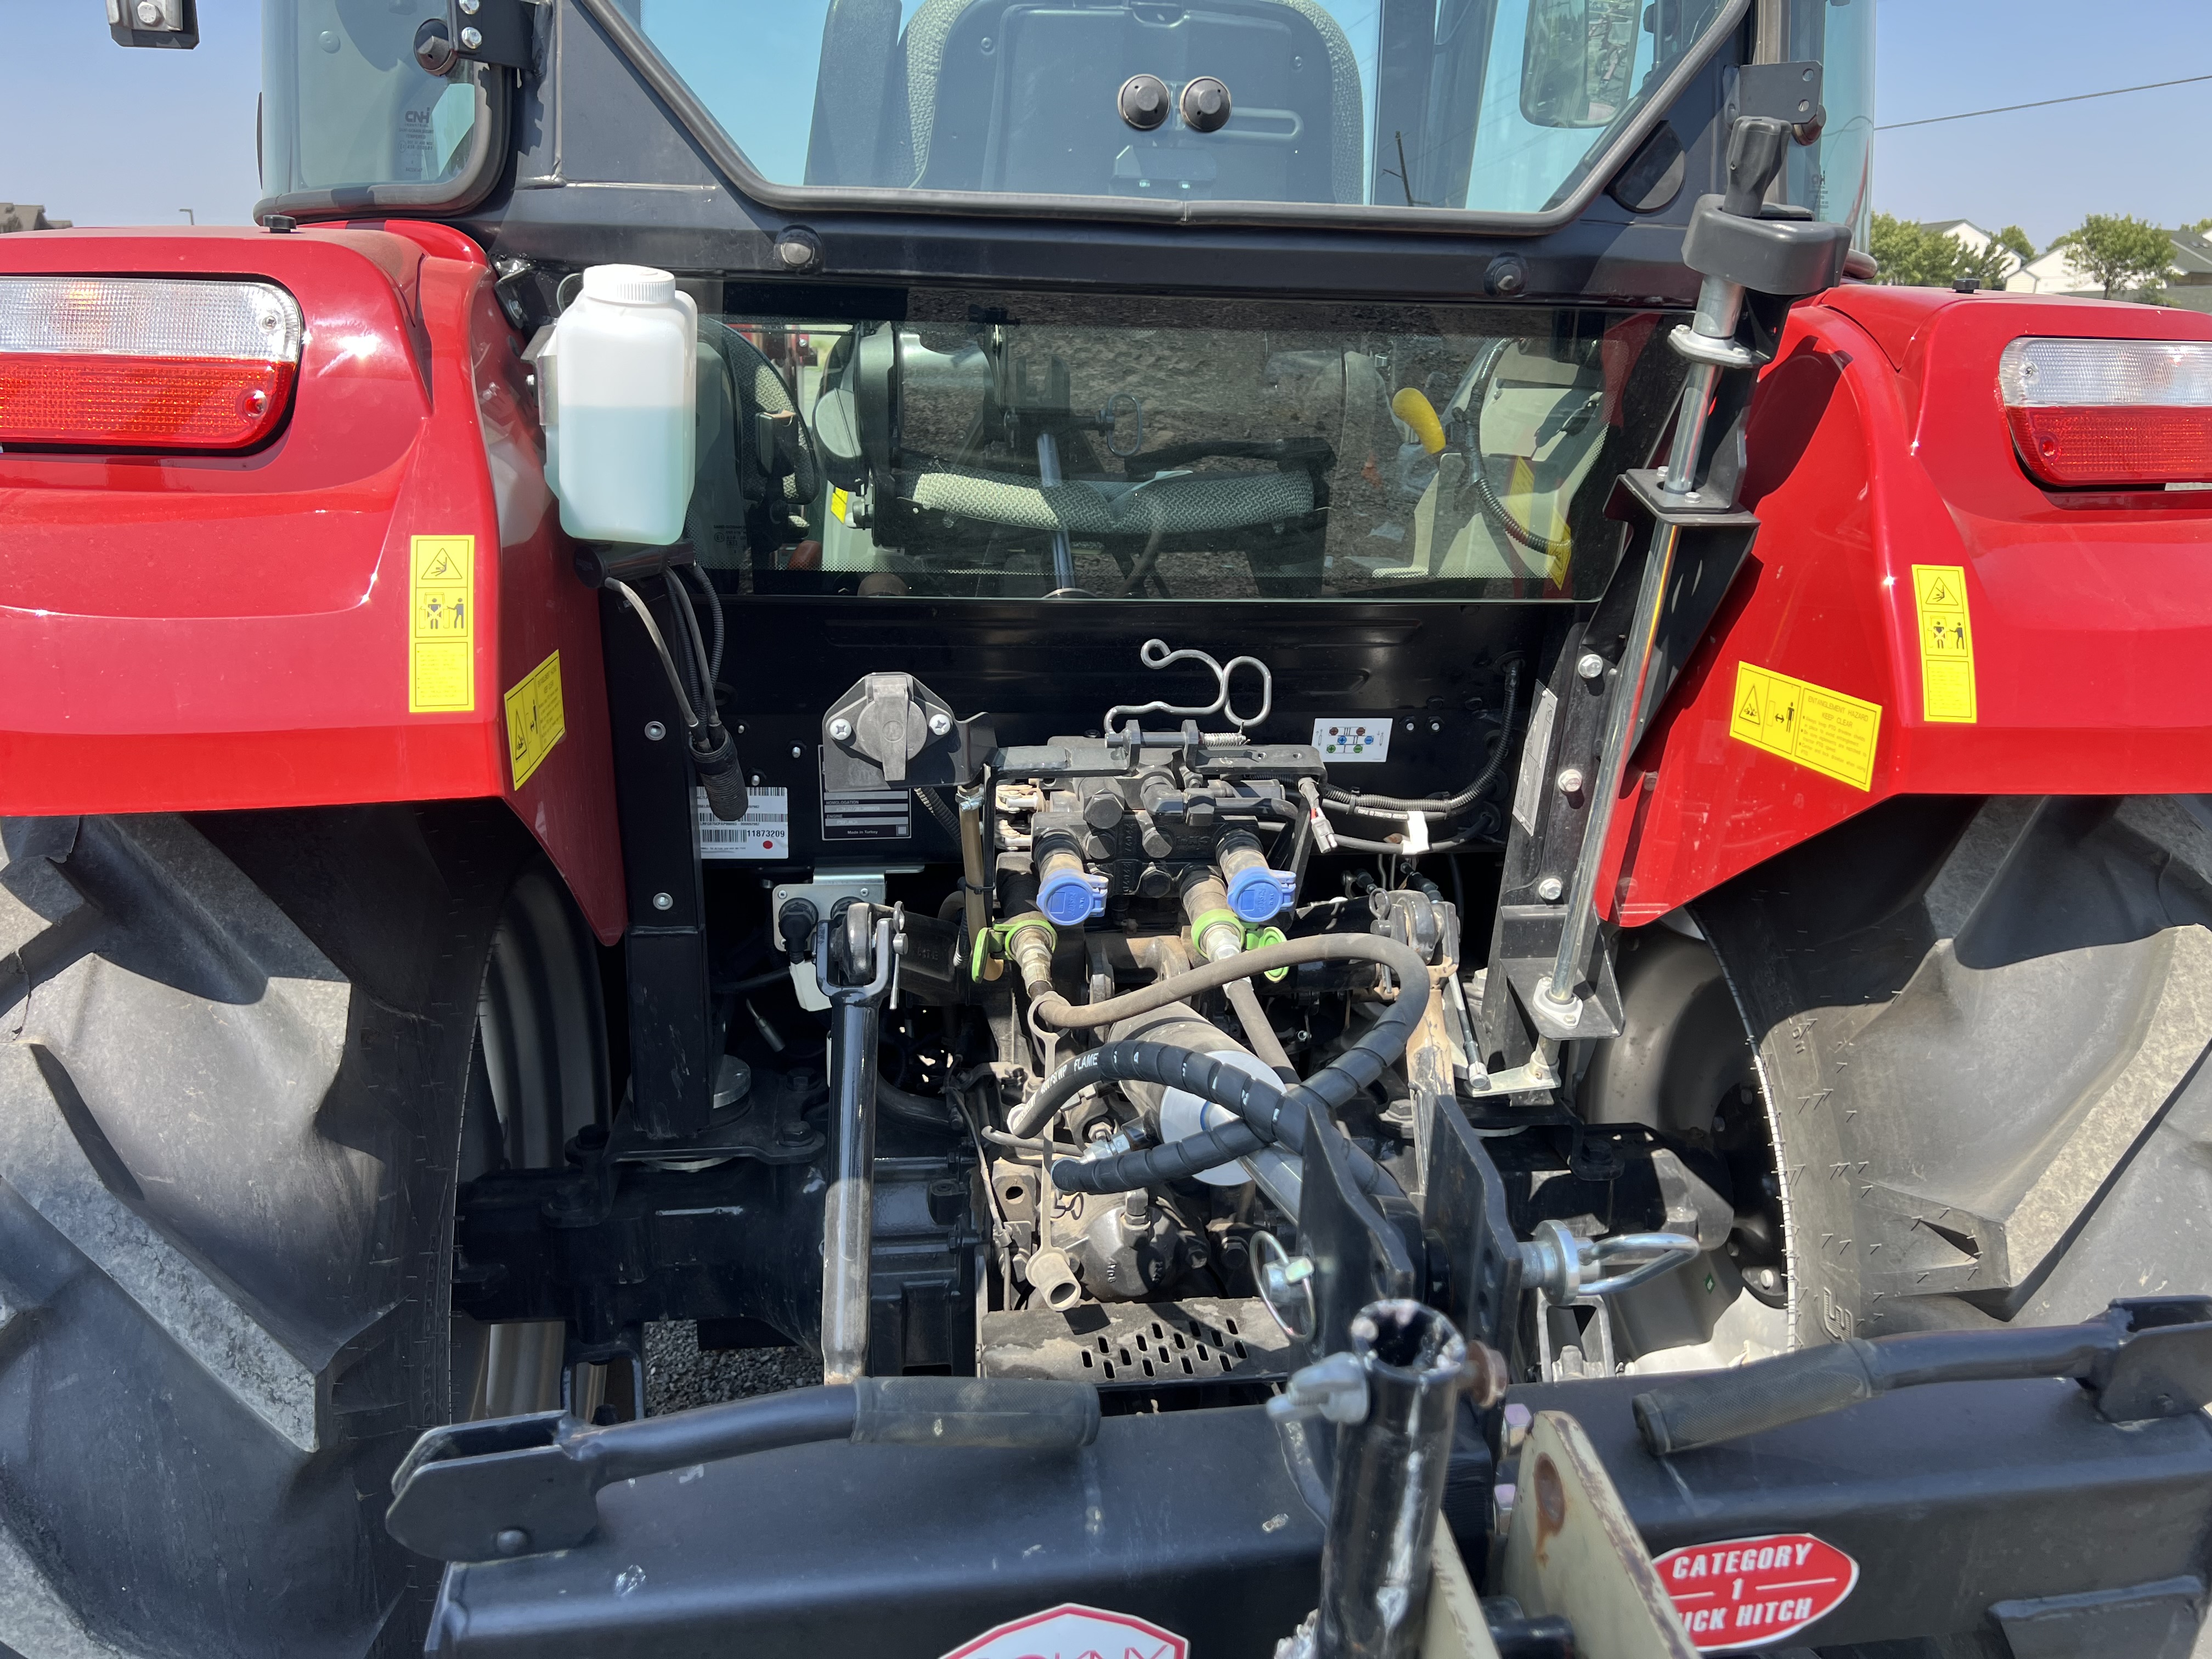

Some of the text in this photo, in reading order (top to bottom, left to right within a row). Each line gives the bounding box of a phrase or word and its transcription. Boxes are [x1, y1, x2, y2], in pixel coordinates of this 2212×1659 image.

[1808, 696, 1869, 722] ENTANGLEMENT HAZARD
[1836, 717, 1853, 728] CLEAR
[747, 830, 785, 838] 11873209
[1074, 1052, 1099, 1072] FLAME
[1672, 1542, 1814, 1579] CATEGORY
[1731, 1578, 1745, 1601] 1
[1679, 1598, 1814, 1632] ICK HITCH
